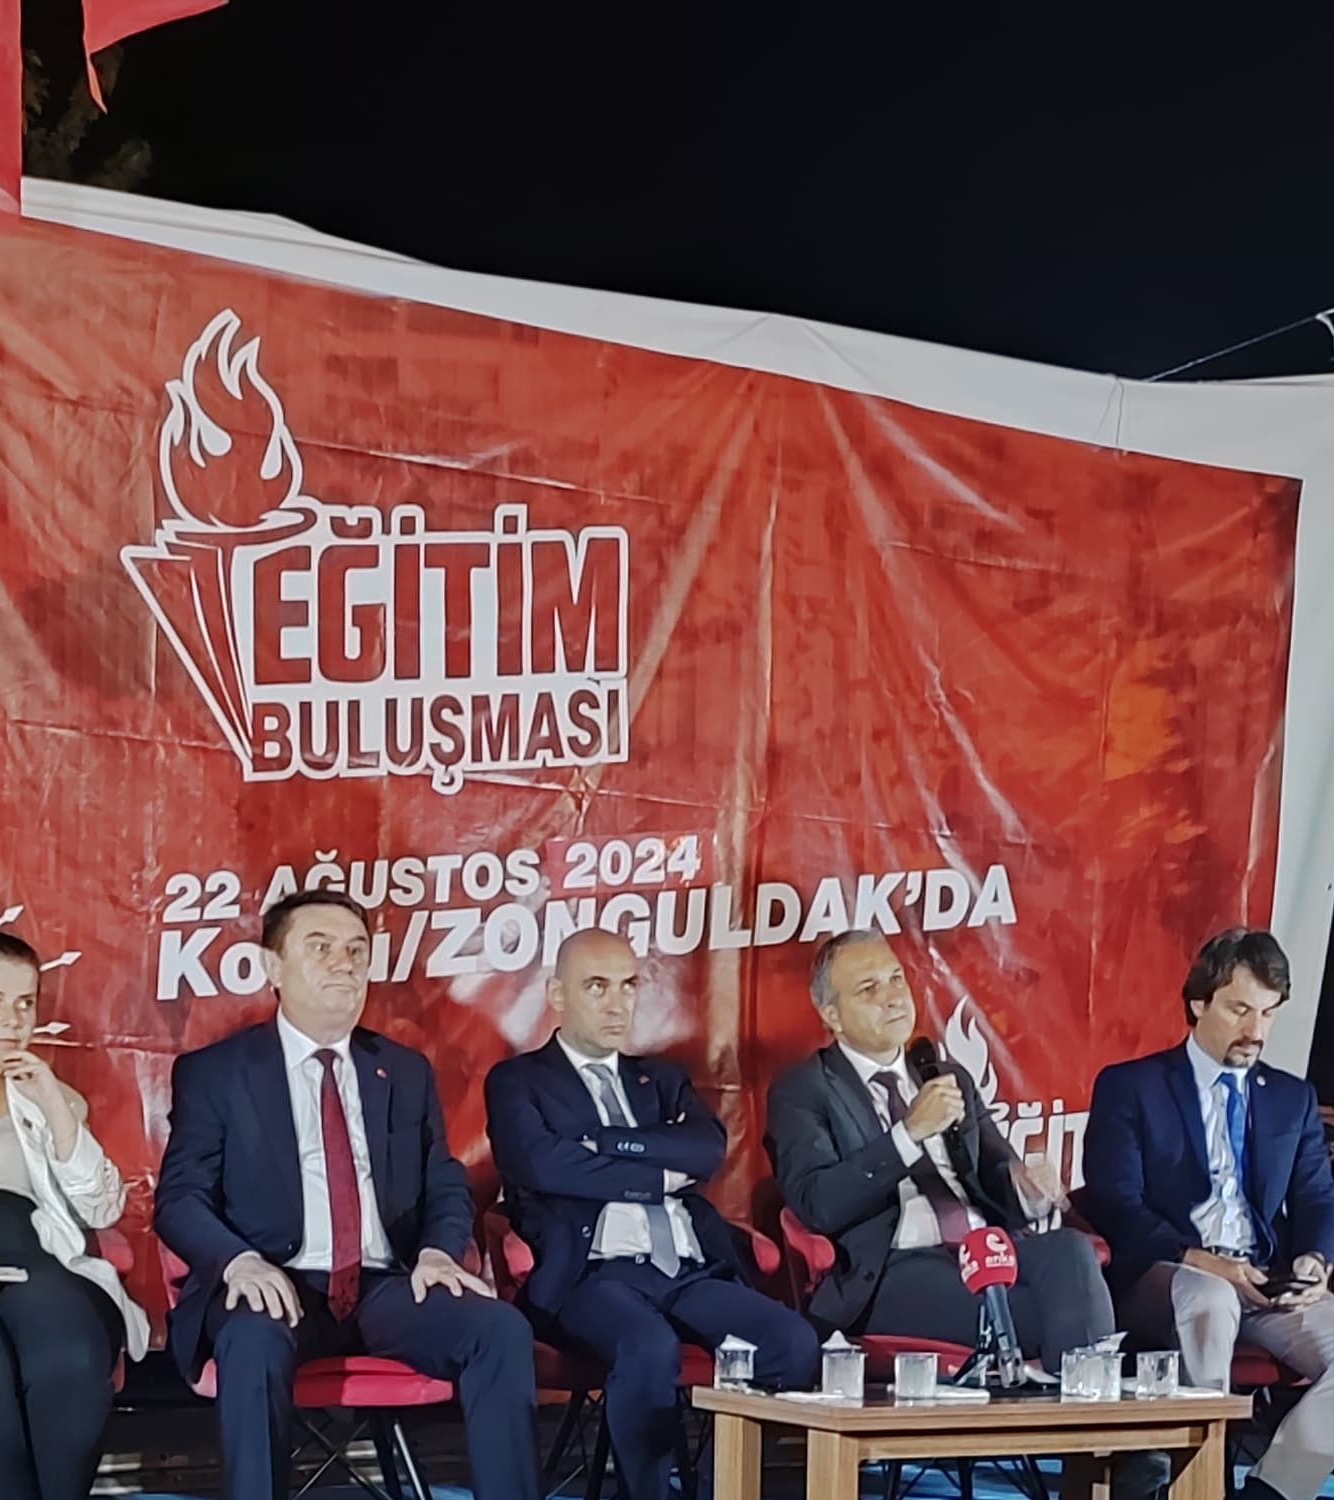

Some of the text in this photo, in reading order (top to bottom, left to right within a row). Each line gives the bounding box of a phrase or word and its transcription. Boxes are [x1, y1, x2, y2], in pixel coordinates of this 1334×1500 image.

[250, 506, 623, 688] EĞİTİM
[248, 687, 625, 787] BULUŞMASI
[162, 834, 702, 923] 22 AĞUSTOS 2024
